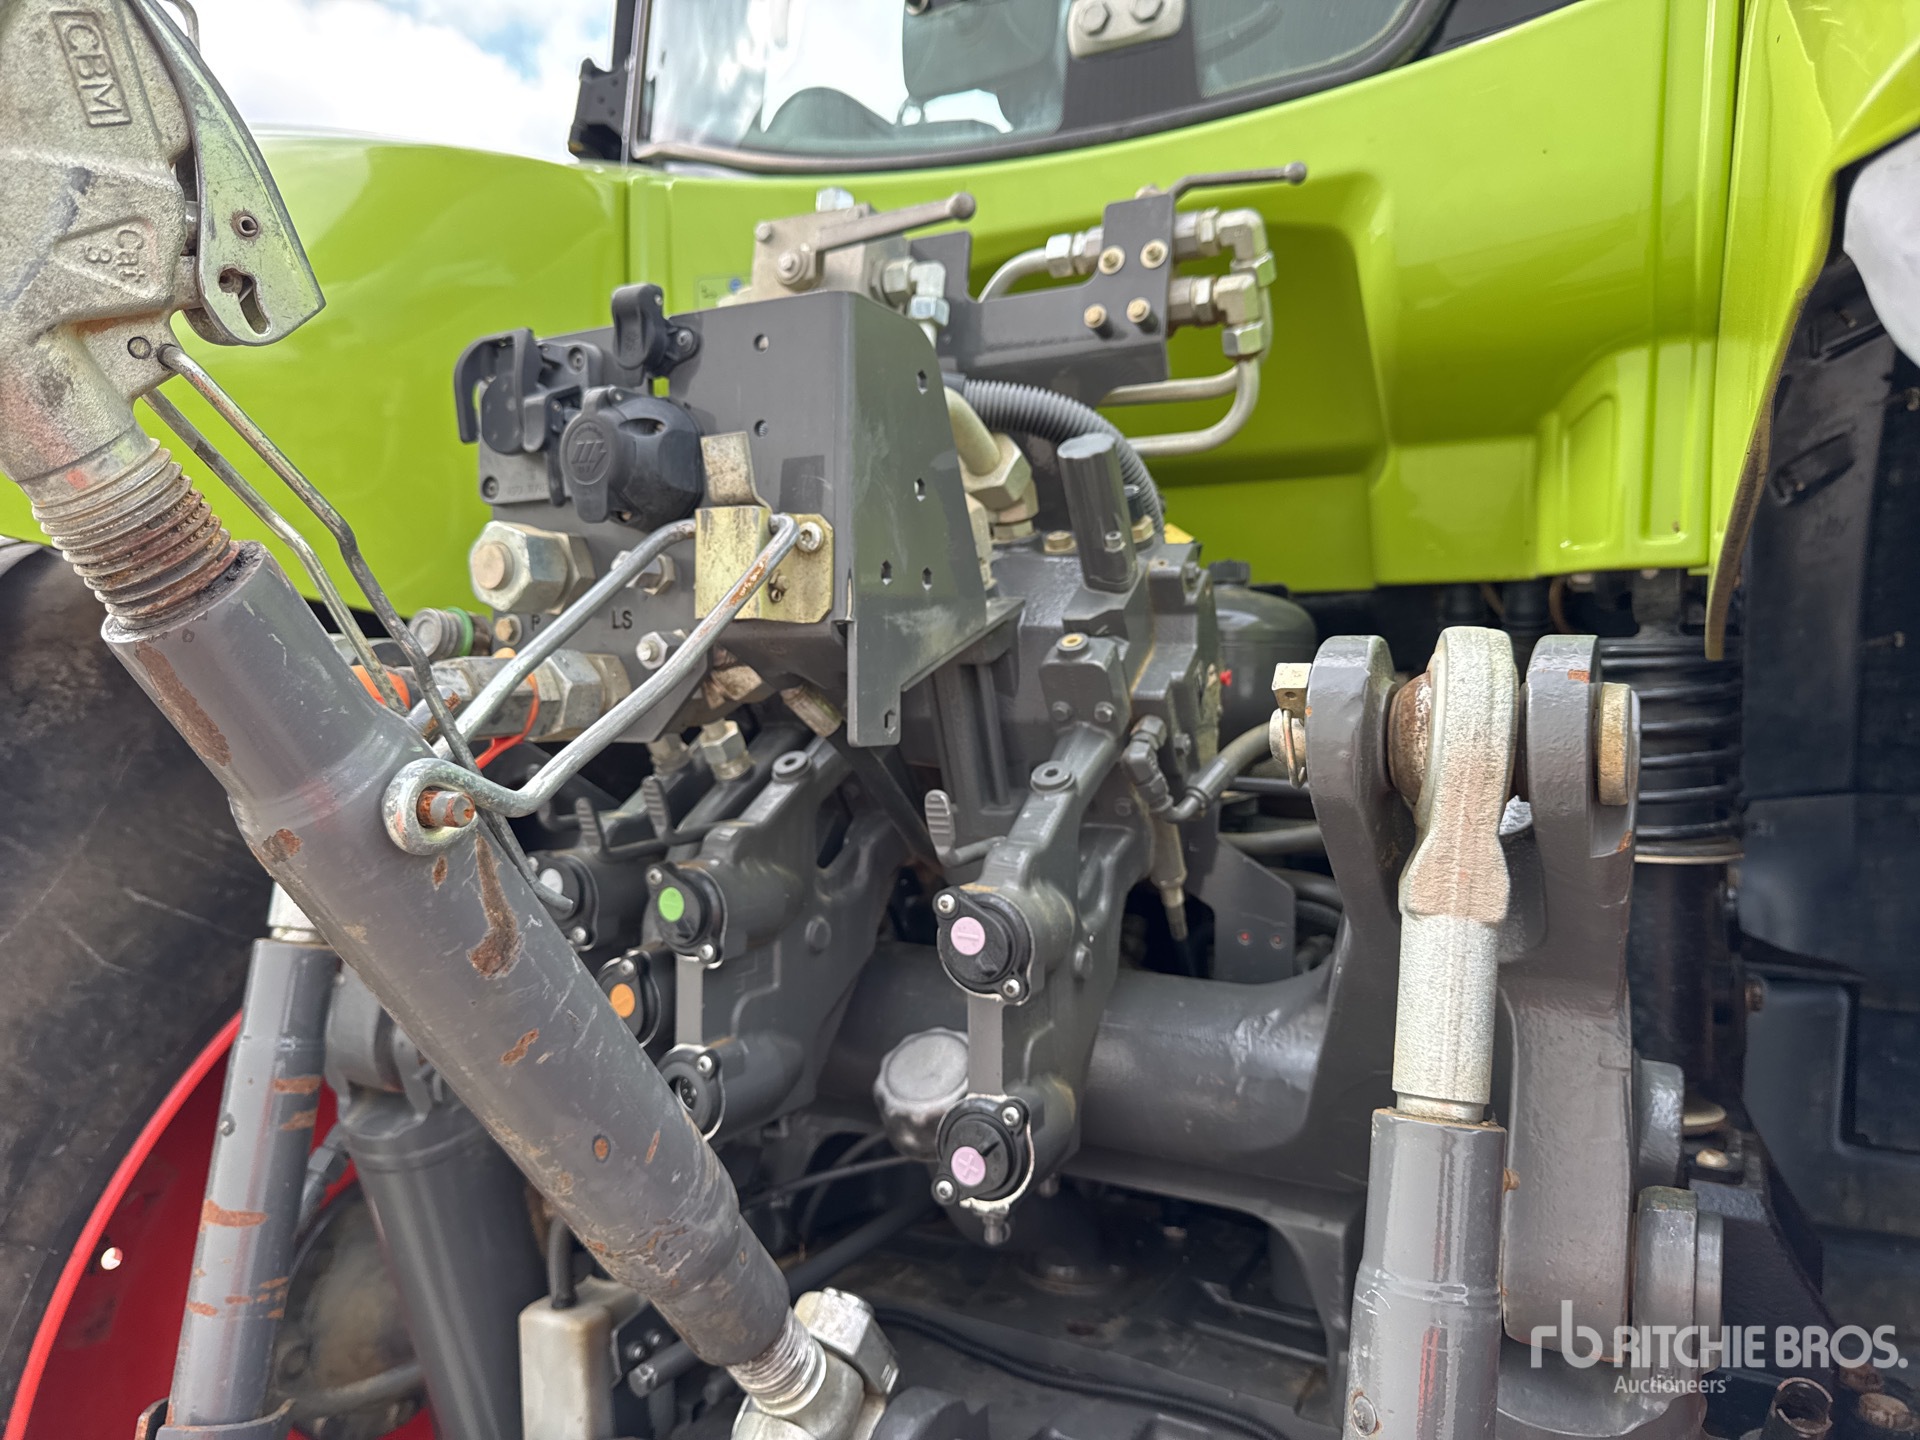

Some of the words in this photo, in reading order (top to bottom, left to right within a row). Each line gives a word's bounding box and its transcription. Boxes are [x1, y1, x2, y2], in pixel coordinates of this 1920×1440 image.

[64, 23, 123, 116] CBM
[84, 246, 112, 264] 3
[116, 229, 145, 283] Cat
[531, 614, 541, 631] P
[611, 610, 633, 630] LS
